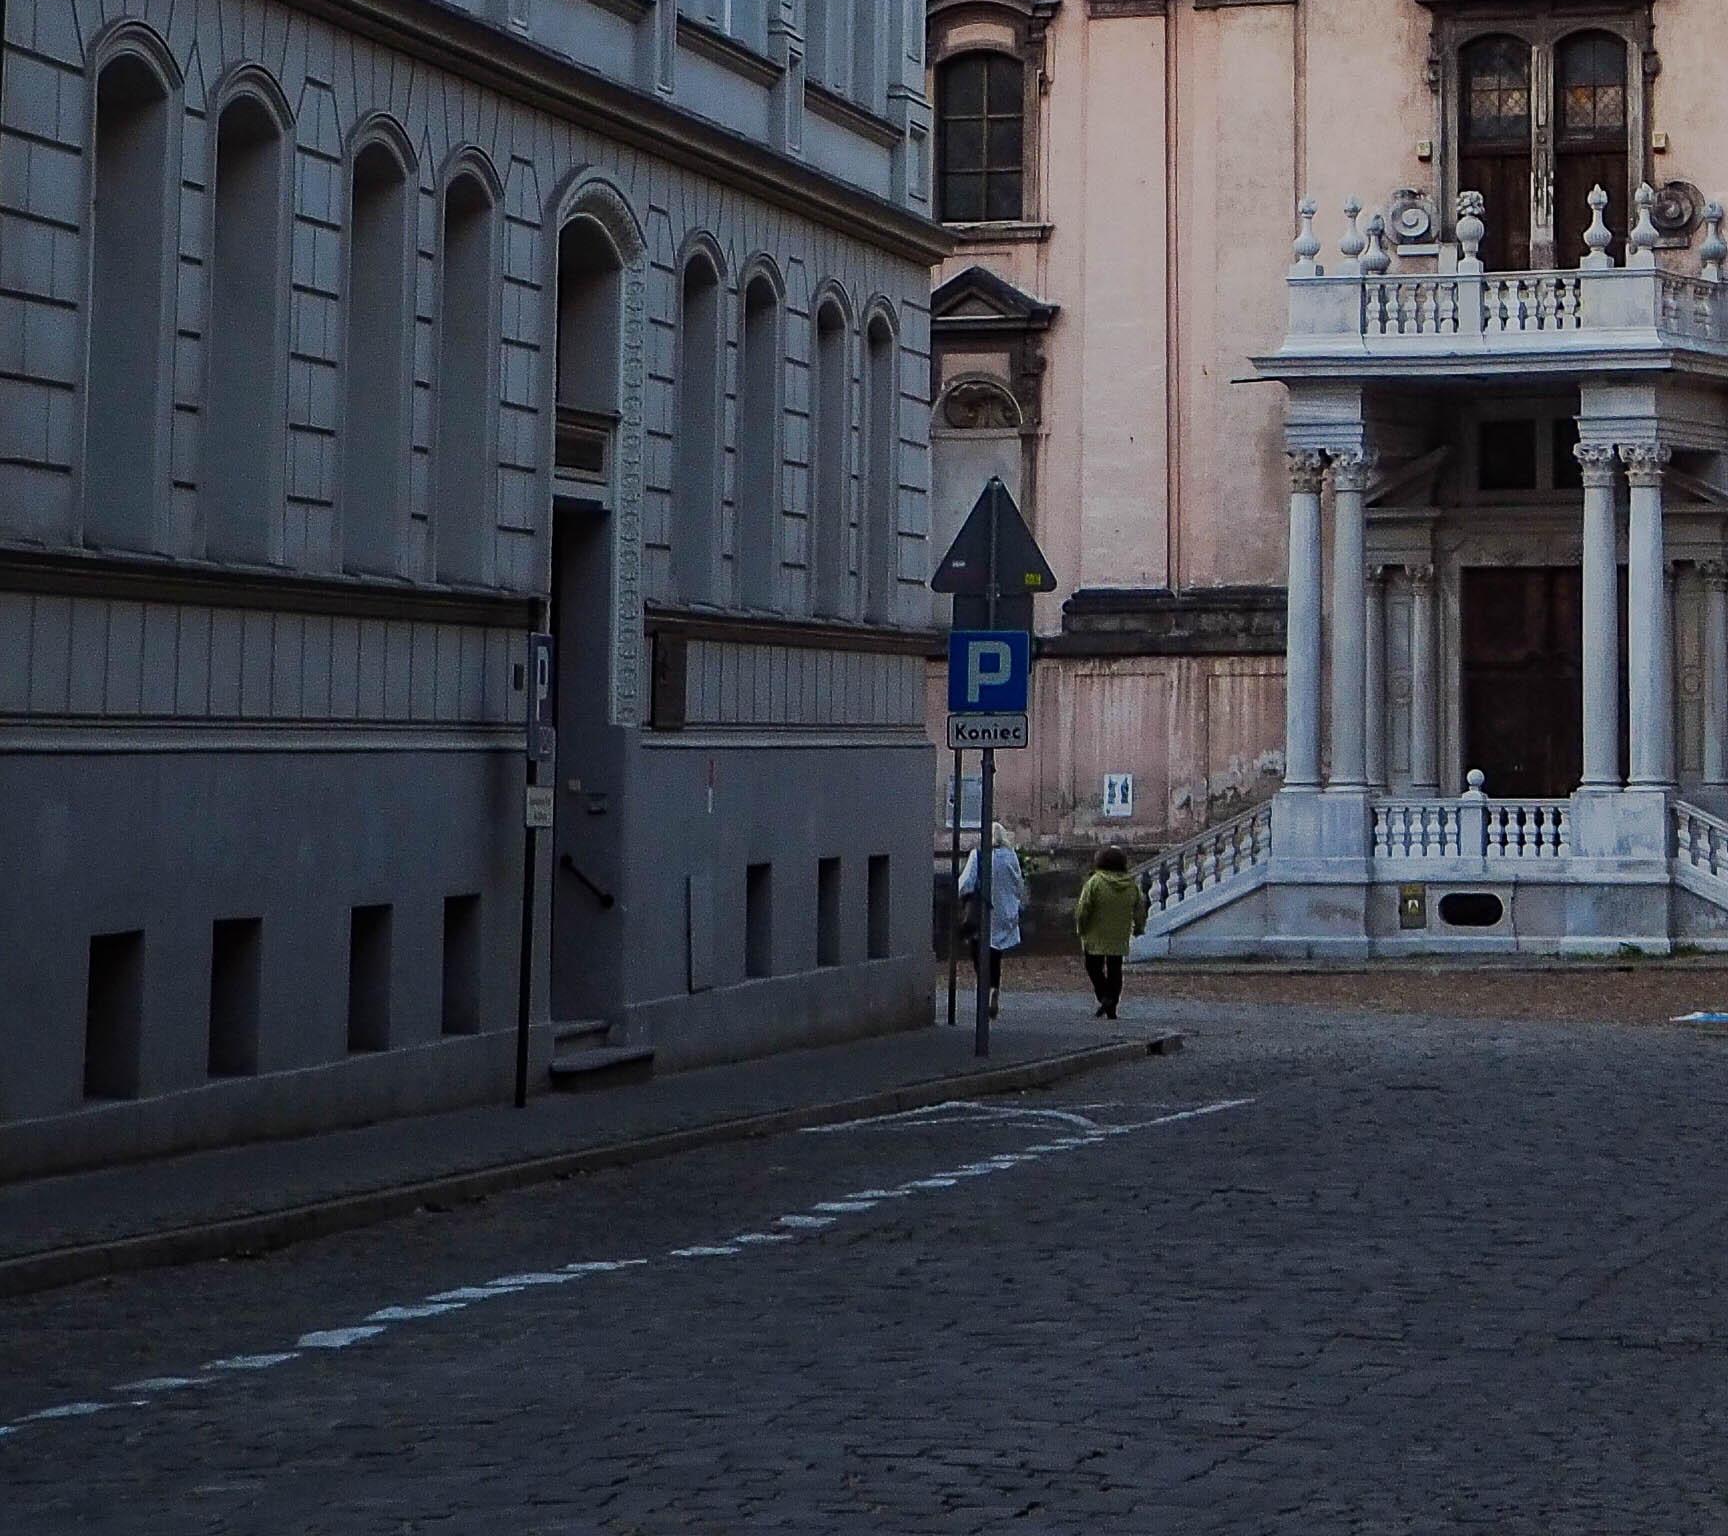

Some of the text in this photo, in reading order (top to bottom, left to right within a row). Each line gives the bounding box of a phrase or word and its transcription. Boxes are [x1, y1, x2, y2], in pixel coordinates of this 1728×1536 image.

[536, 645, 549, 721] P
[967, 640, 1011, 703] P
[955, 723, 1021, 741] Koniec
